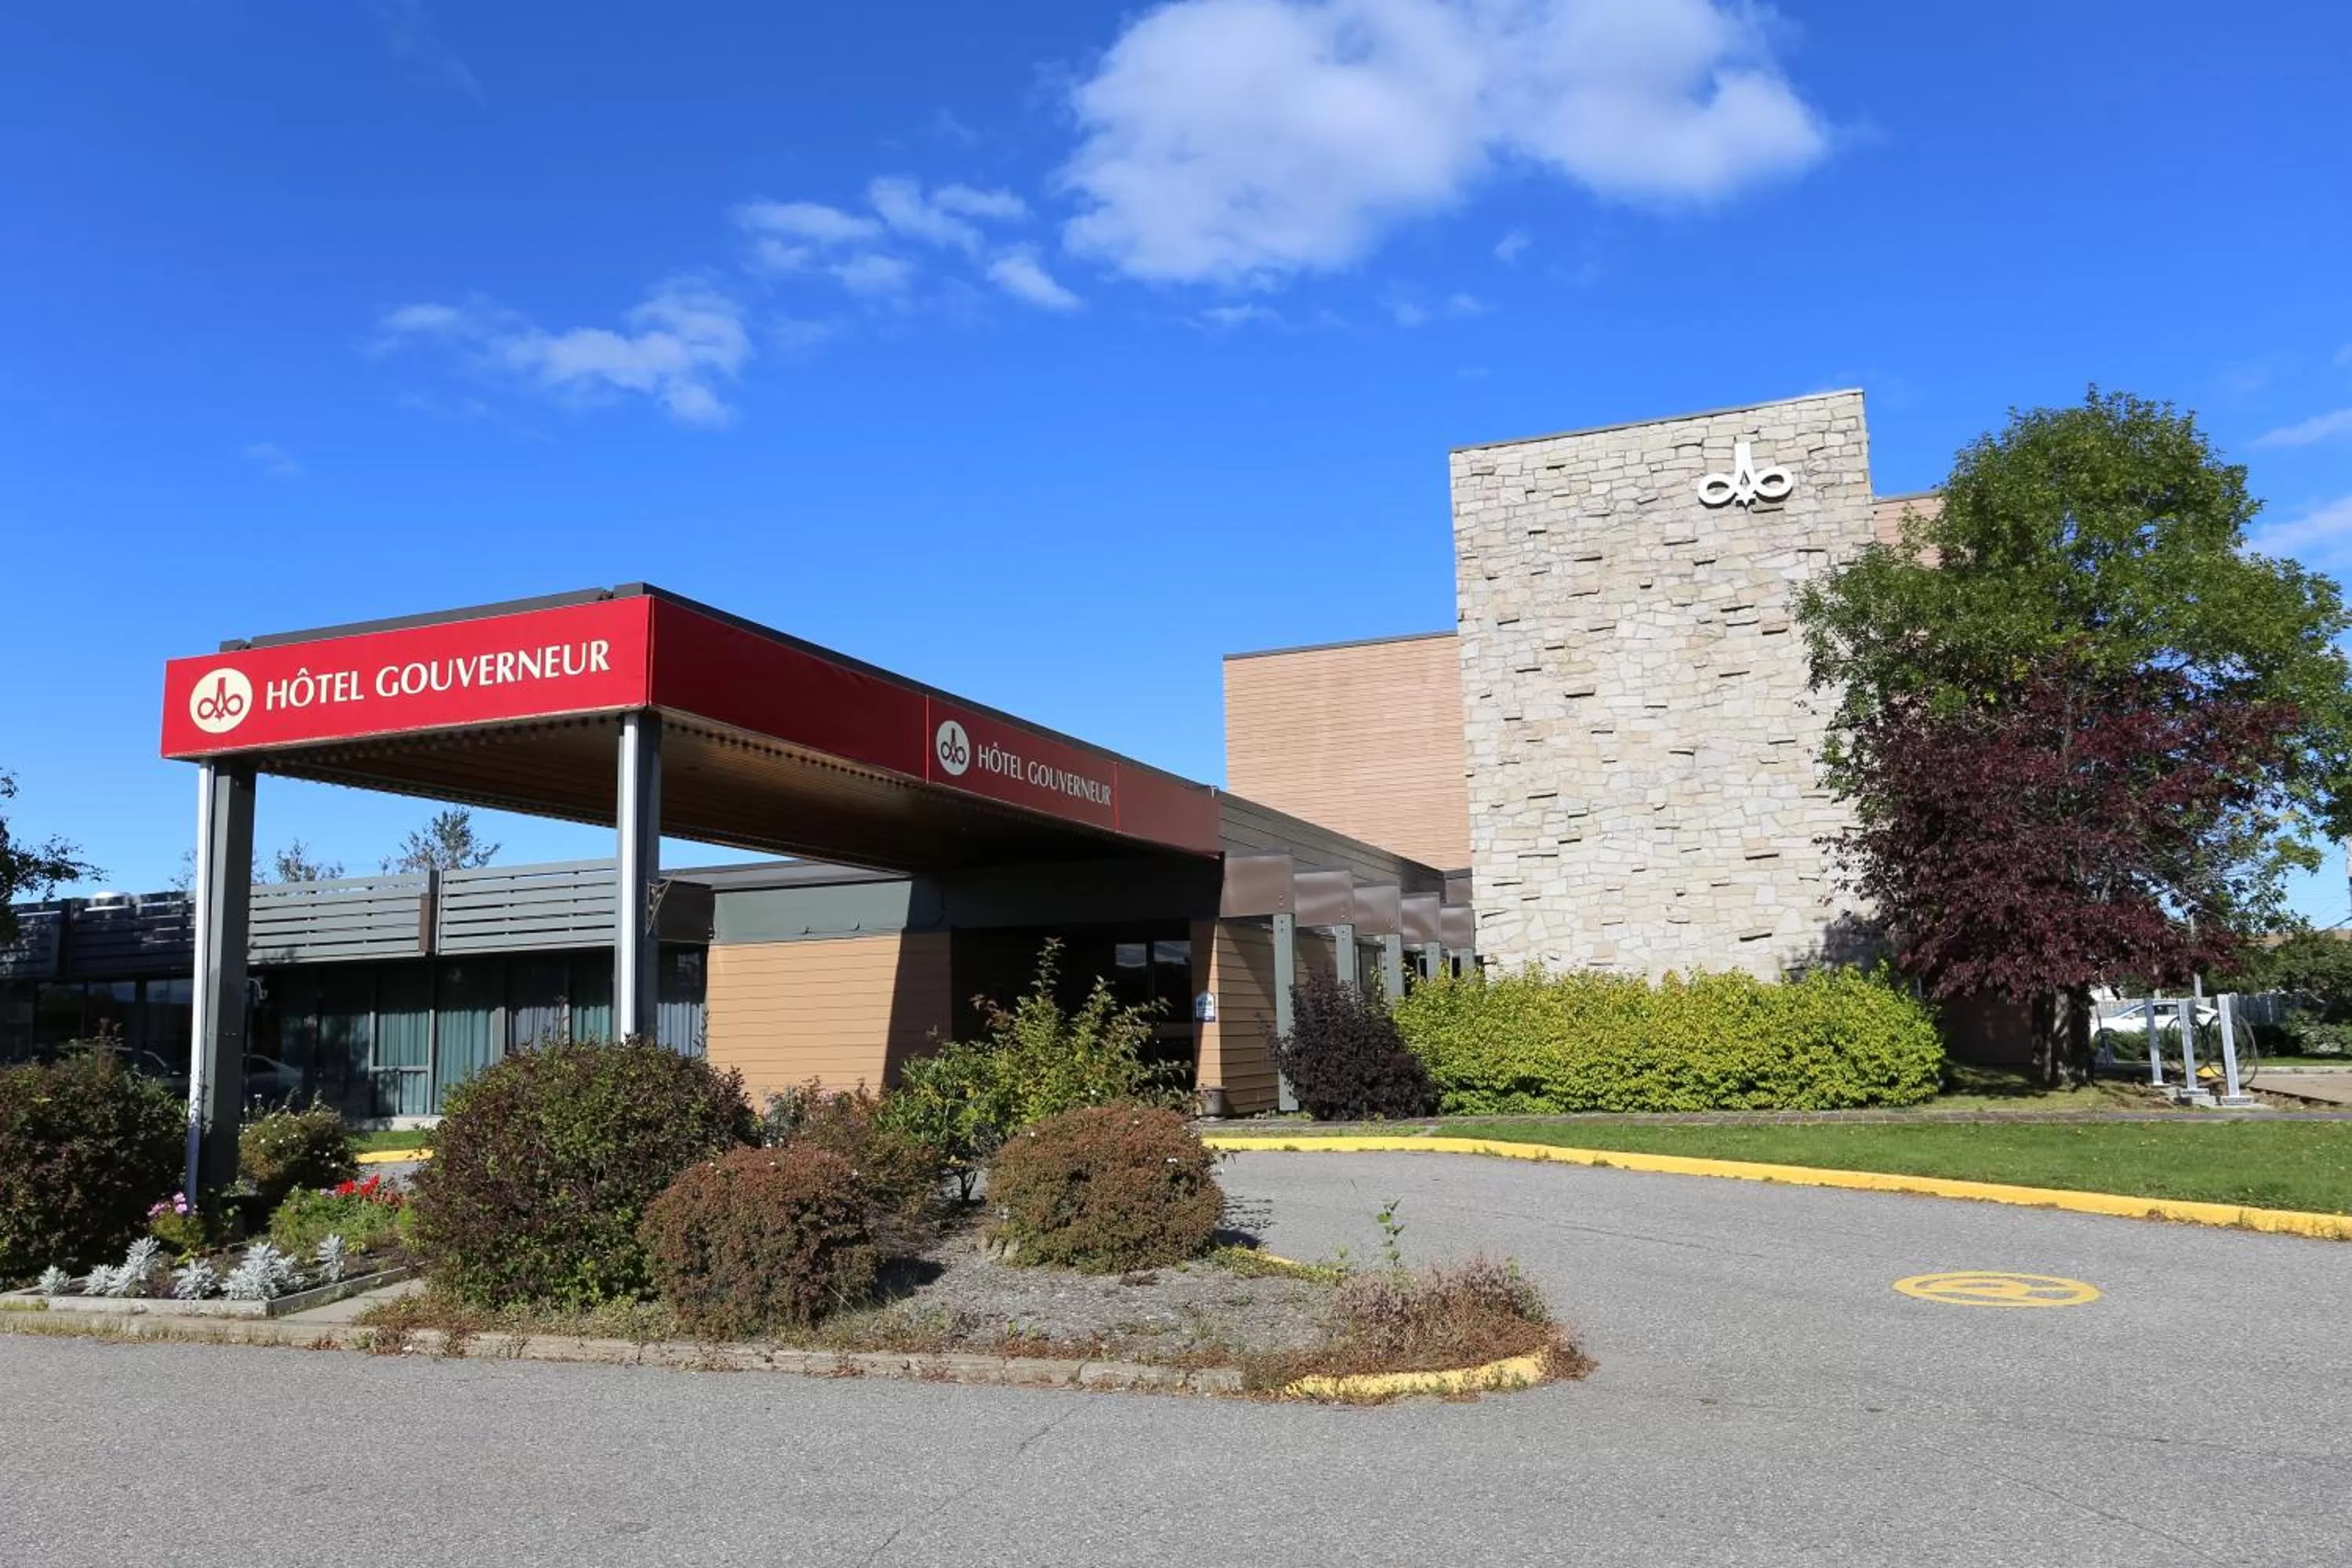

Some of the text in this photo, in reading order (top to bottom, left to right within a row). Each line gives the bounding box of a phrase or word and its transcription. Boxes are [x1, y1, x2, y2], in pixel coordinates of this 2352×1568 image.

[265, 640, 610, 710] HÔTEL GOUVERNEUR
[978, 741, 1111, 806] HÔTEL GOUVERNEUR
